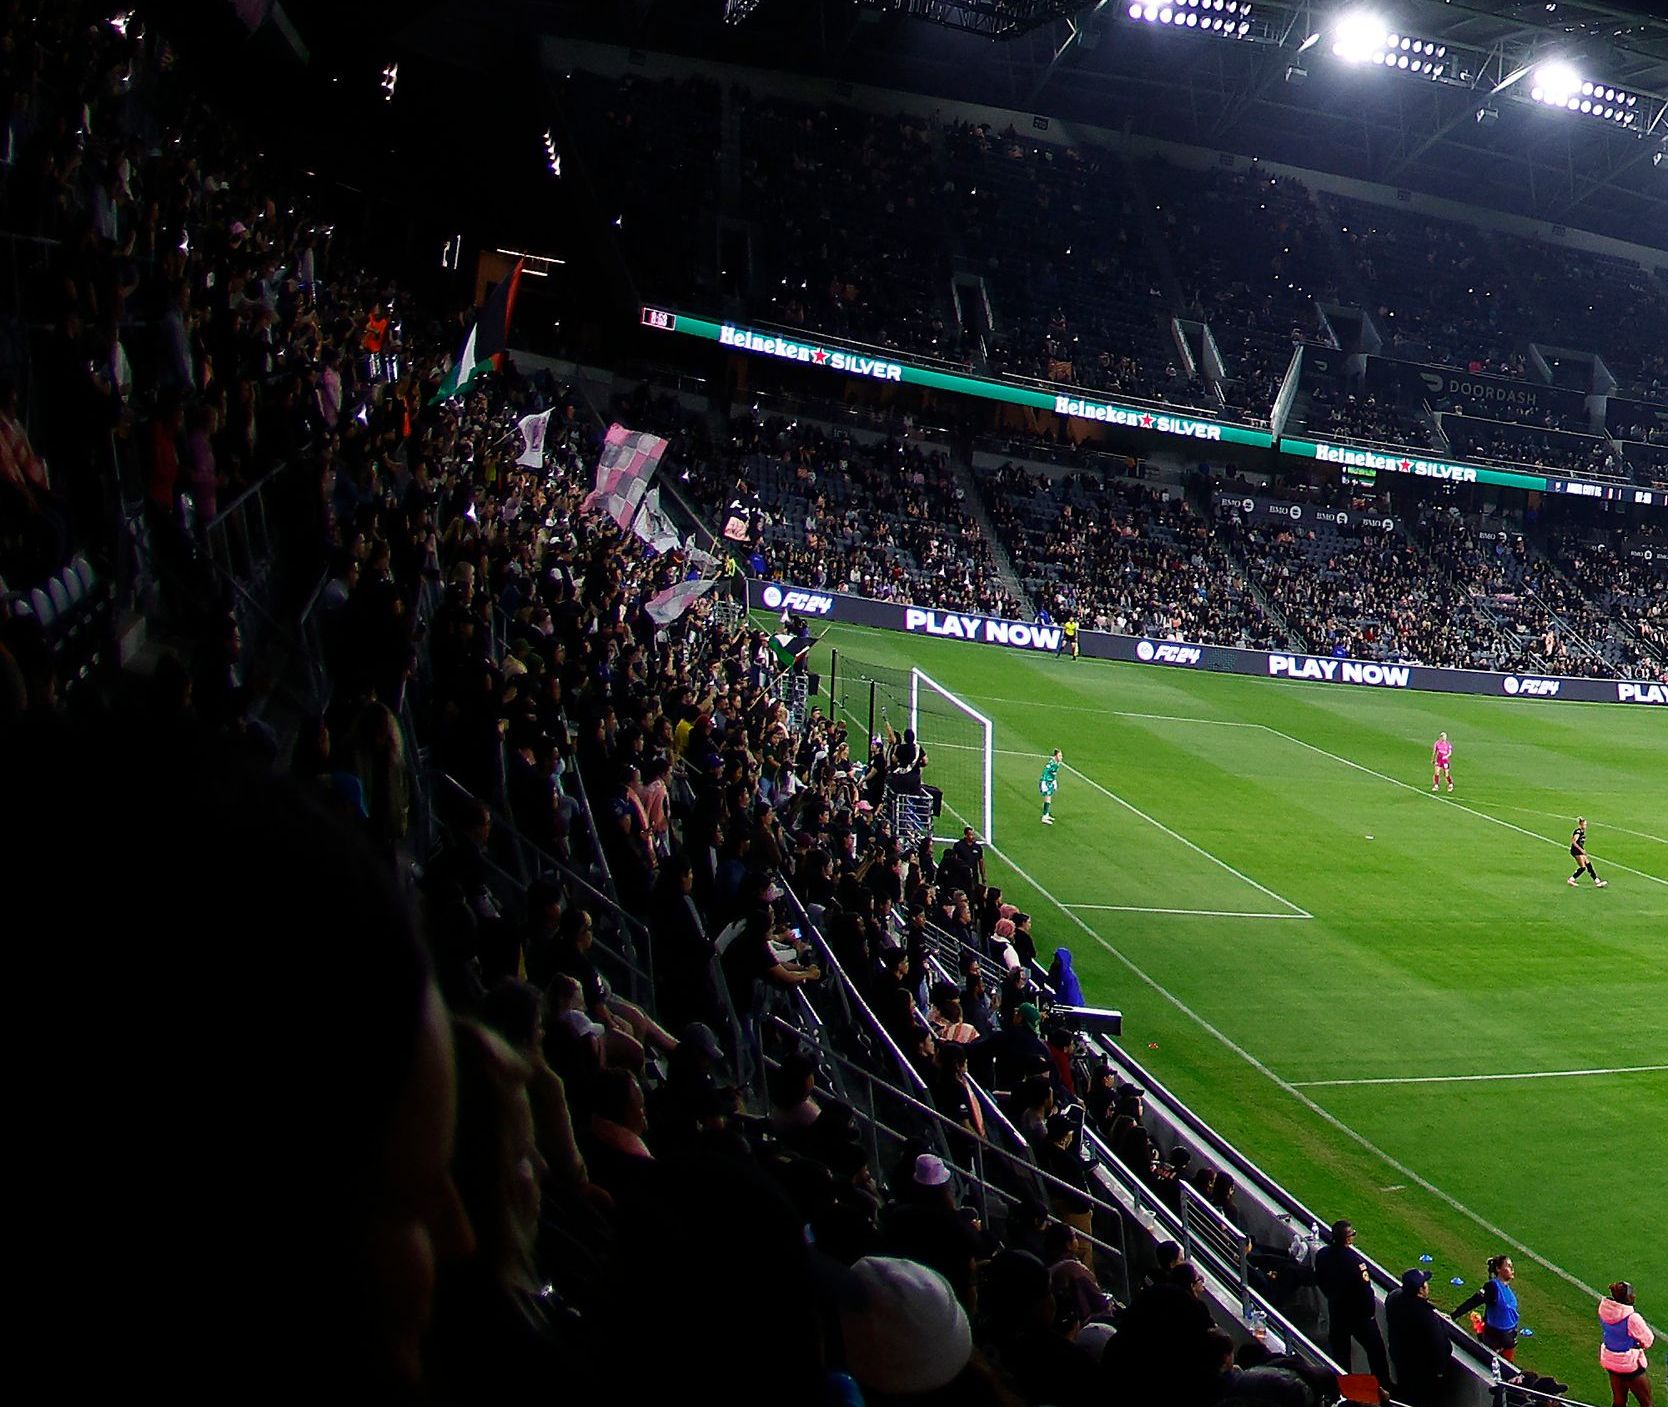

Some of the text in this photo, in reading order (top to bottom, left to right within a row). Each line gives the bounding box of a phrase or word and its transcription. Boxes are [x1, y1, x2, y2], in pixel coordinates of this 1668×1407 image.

[719, 325, 902, 382] Heineken SILVER
[1450, 380, 1537, 405] DOORDASH
[1055, 396, 1221, 441] Heineken SILVER
[1315, 444, 1477, 482] Heineken SILVER
[1269, 505, 1288, 514] BMO
[1316, 512, 1335, 521] BMO
[781, 592, 832, 613] FC24
[905, 609, 1062, 650] PLAY NOW
[1154, 645, 1200, 664] FC24
[1268, 655, 1410, 687] PLAY NOW
[1519, 679, 1559, 695] FC24
